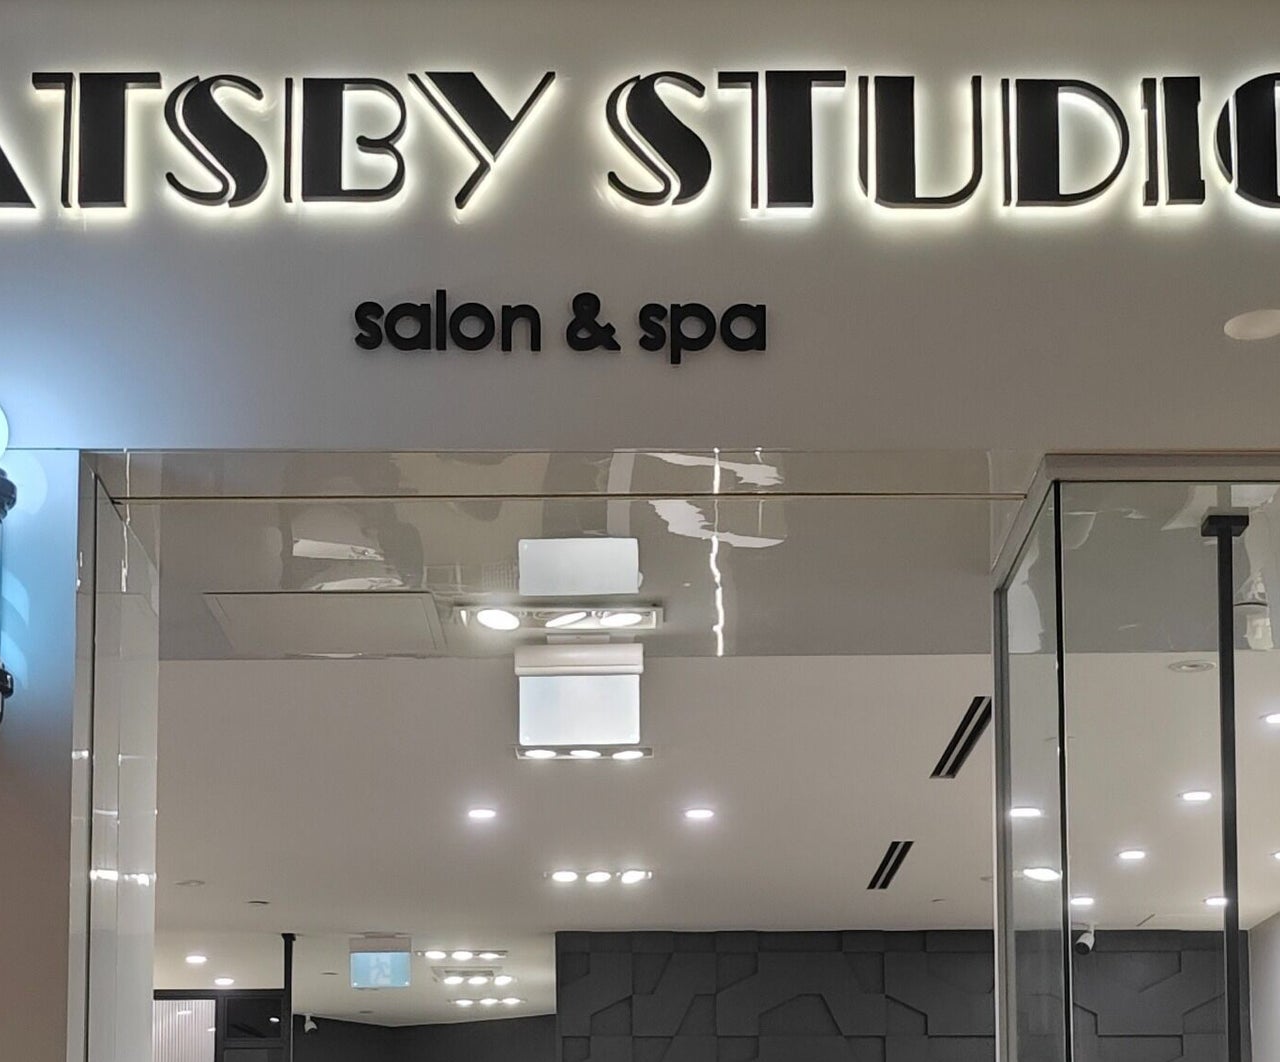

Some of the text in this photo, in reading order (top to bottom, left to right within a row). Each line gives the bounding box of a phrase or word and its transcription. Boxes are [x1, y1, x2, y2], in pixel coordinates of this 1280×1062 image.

[356, 289, 768, 367] salon & spa
